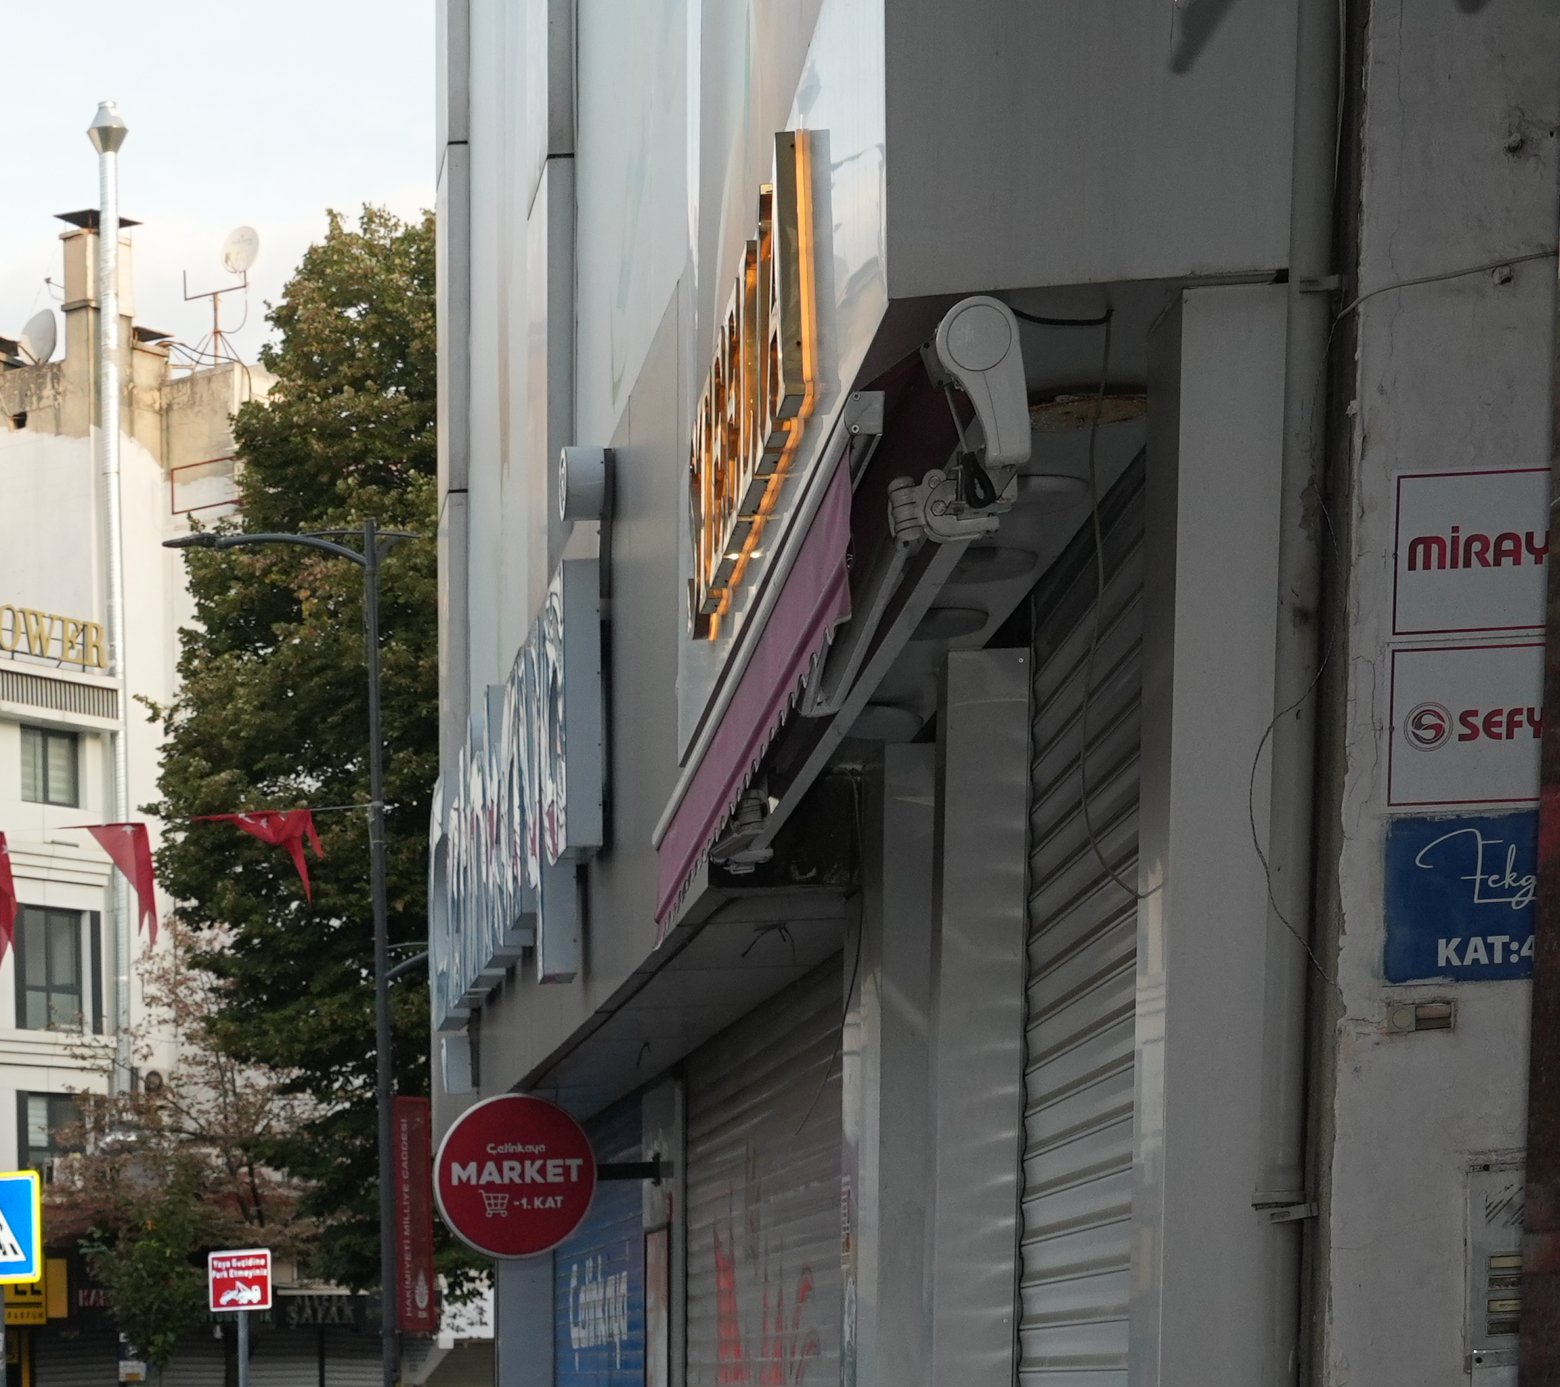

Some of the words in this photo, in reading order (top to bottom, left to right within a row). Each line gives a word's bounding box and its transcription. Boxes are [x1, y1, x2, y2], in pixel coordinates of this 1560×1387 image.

[1407, 525, 1549, 572] MİRAY
[486, 1143, 546, 1156] Çetinkaya
[451, 1158, 584, 1186] MARKET
[533, 1195, 564, 1209] KAT
[212, 1259, 230, 1271] Yaya
[212, 1269, 229, 1279] Park
[5, 1310, 46, 1321] PARFUM
